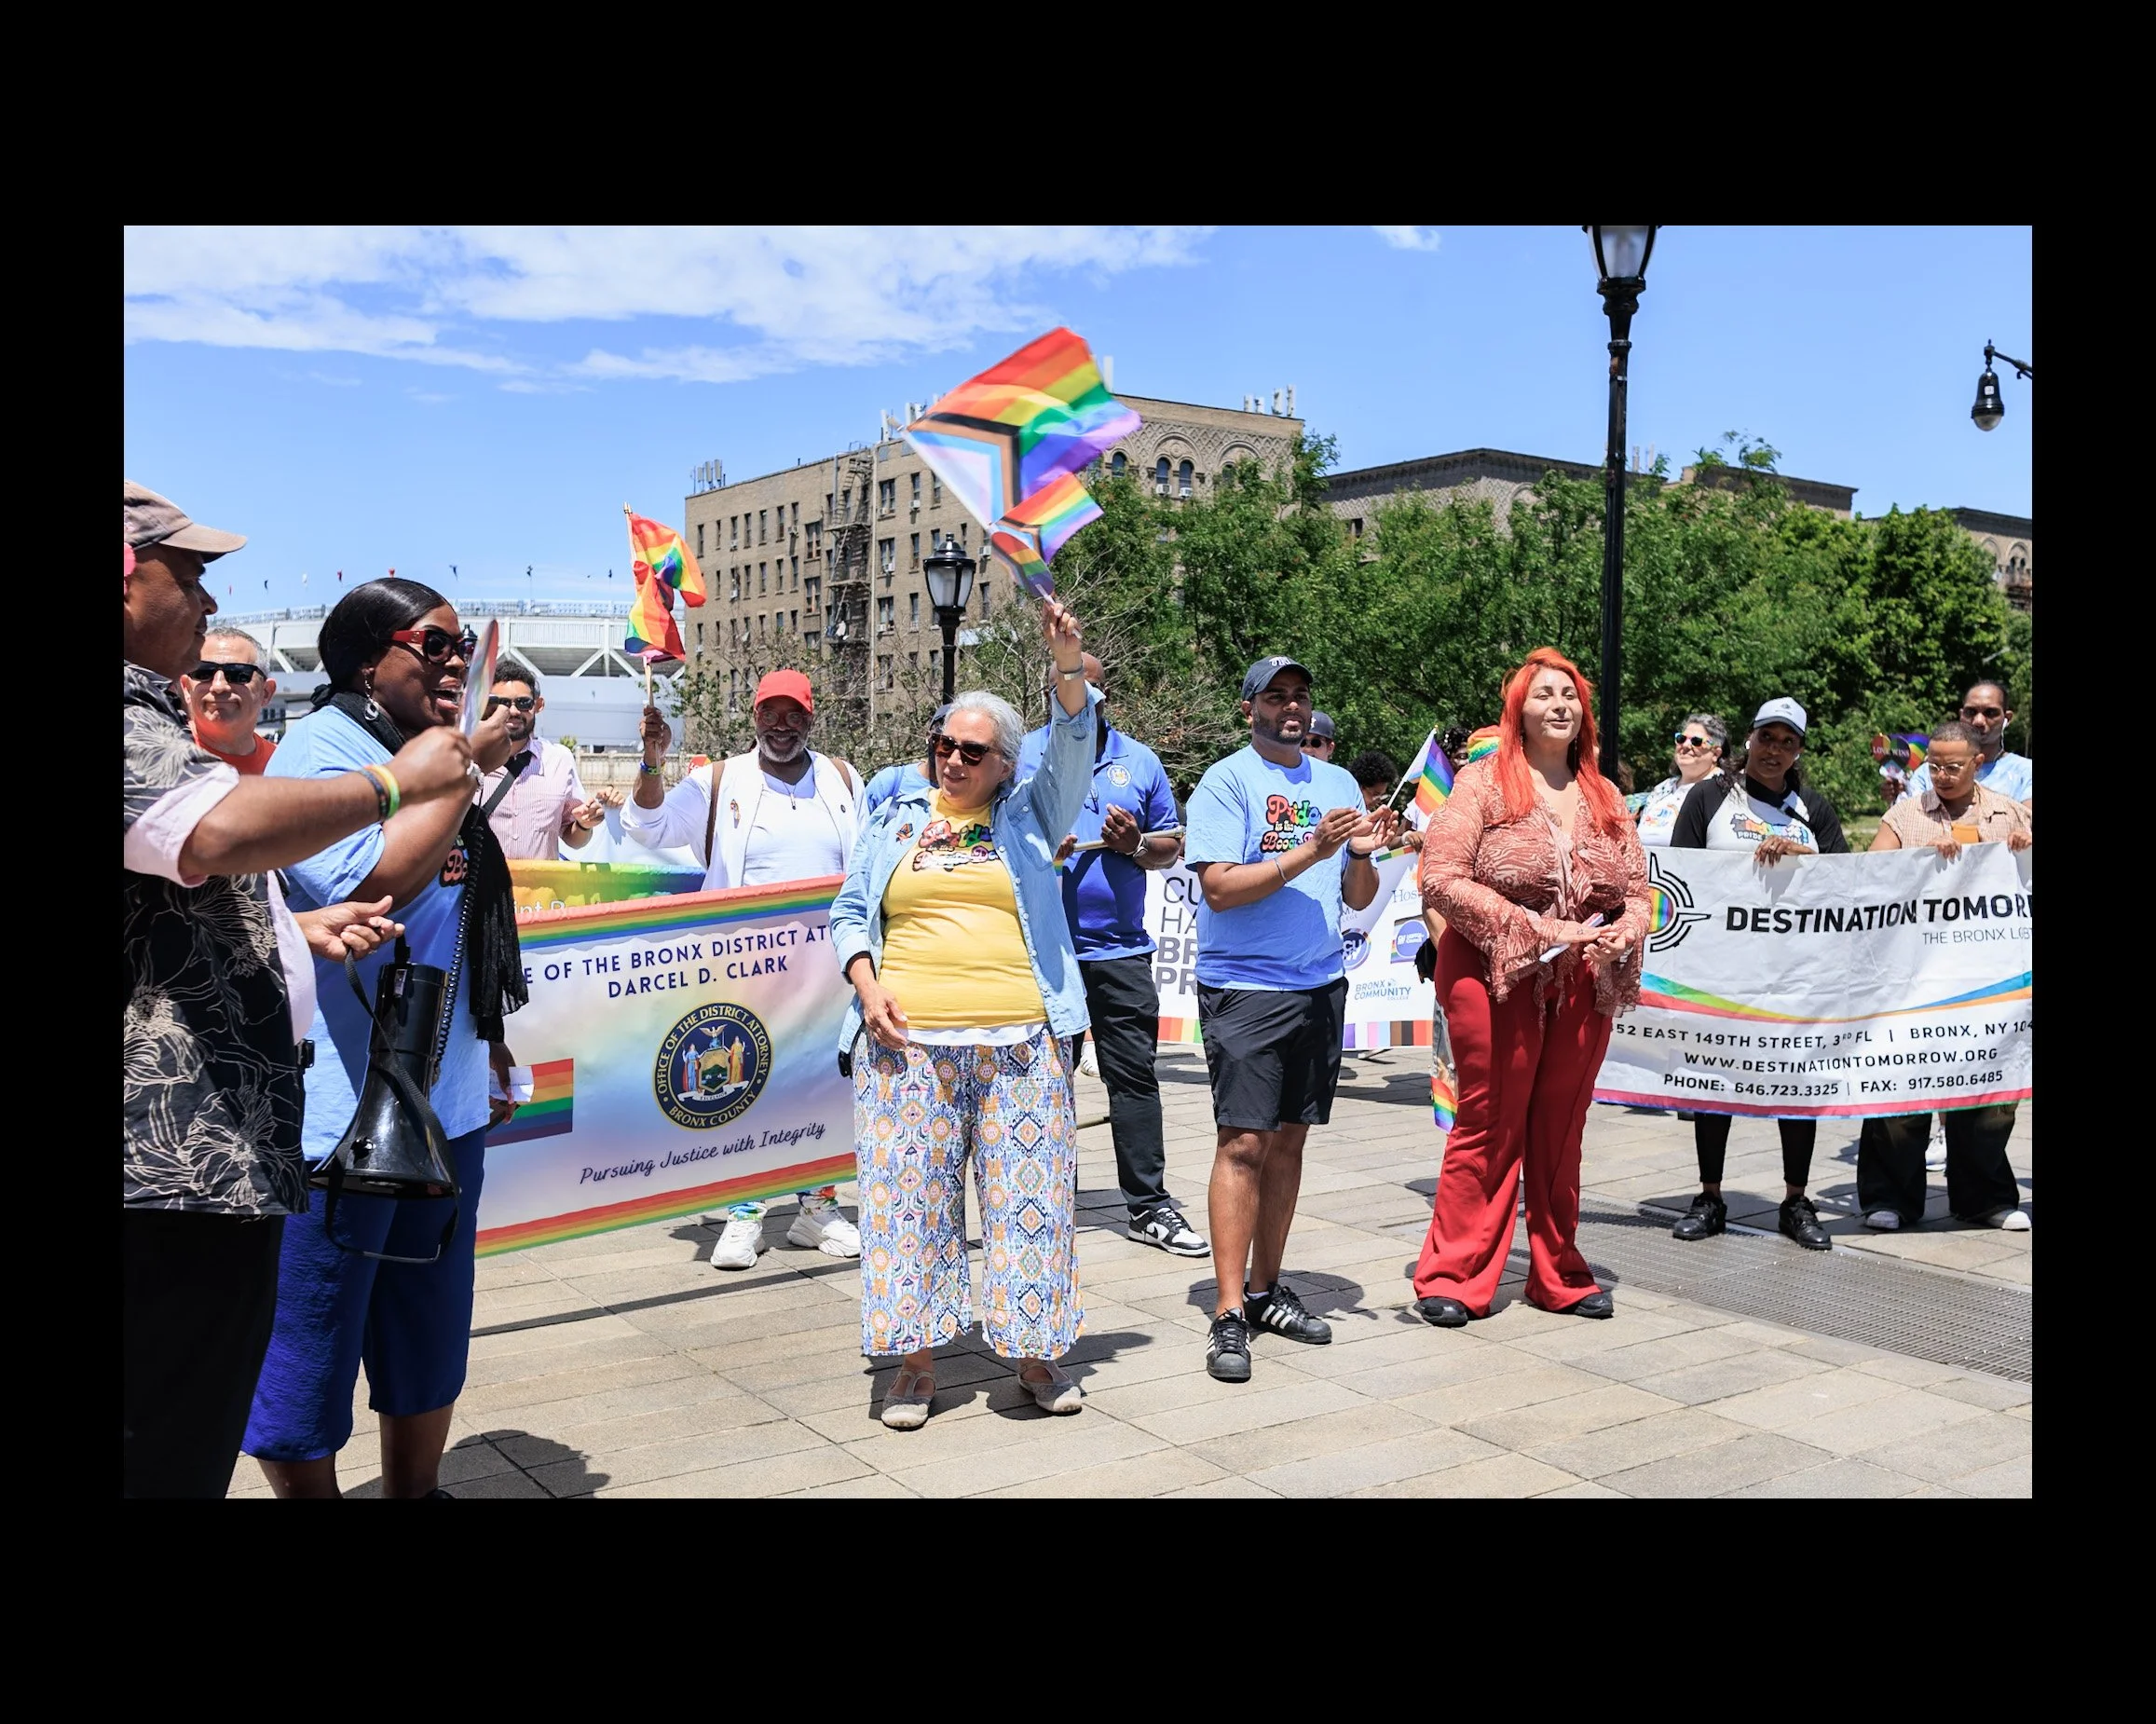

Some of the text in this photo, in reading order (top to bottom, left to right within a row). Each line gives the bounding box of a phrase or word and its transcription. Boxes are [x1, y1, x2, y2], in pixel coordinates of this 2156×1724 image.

[1891, 748, 1910, 757] WINS
[1266, 794, 1322, 828] Pride
[1726, 899, 1917, 933] DESTINATION
[1922, 931, 1947, 945] THE
[1953, 927, 2006, 943] BRONX
[544, 962, 572, 980] OF
[582, 955, 621, 975] THE
[632, 943, 703, 969] BRONX
[712, 930, 798, 957] DISTRICT
[608, 955, 788, 998] DARCEL D. CLARK
[1356, 979, 1385, 992] BRONX
[1355, 987, 1412, 1001] COMMUNITY
[657, 1006, 769, 1094] OFFICE OF THE DISTRICT ATTORNEY
[1611, 1022, 1637, 1036] 52
[1643, 1026, 1689, 1041] EAST
[1695, 1033, 1752, 1047] 149TH
[1757, 1035, 1827, 1049] STREET,
[1855, 1030, 1873, 1044] FL
[1910, 1024, 1978, 1040] BRONX,
[1985, 1021, 2008, 1036] NY
[1685, 1047, 1998, 1074] WWW.DESTINATIONTOMORROW.ORG
[1664, 1070, 2003, 1097] PHONE: 646.723.3325 FAX: 917.580.6485
[669, 1089, 757, 1127] BRONX COUNTY
[580, 1122, 826, 1184] Pursuing Justice with Integrity
